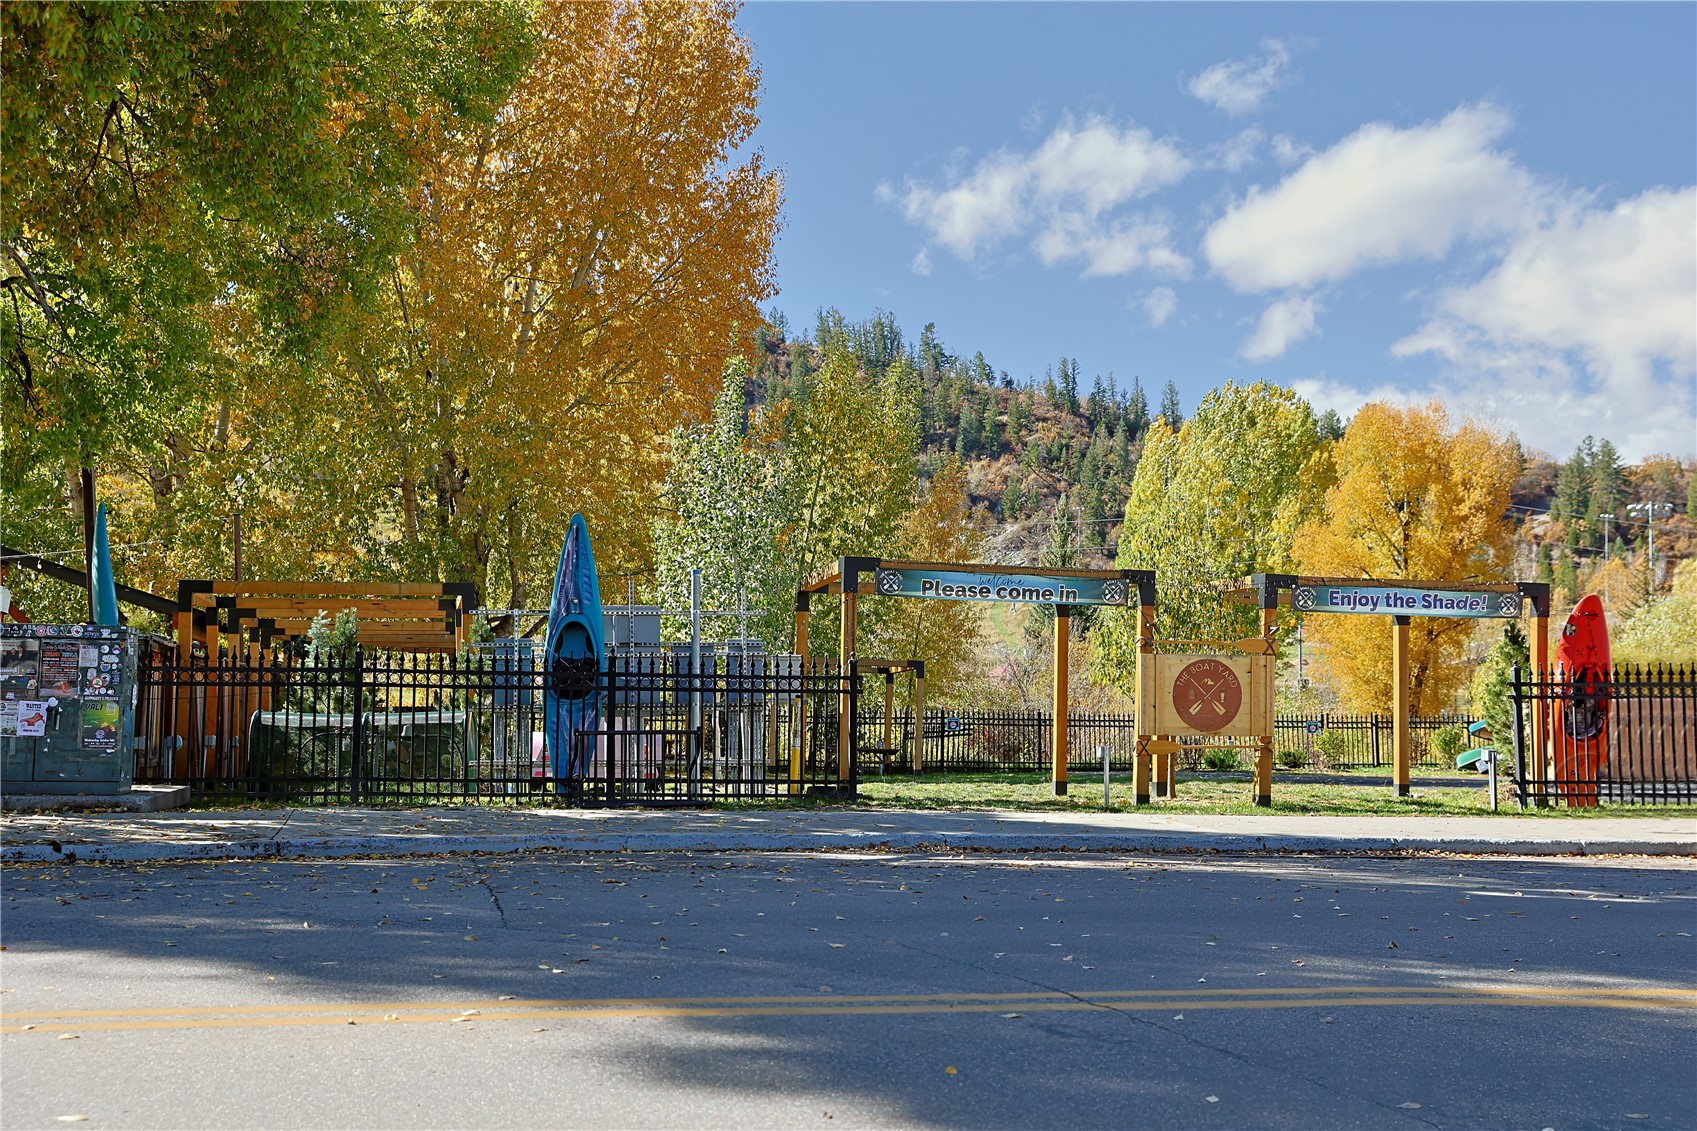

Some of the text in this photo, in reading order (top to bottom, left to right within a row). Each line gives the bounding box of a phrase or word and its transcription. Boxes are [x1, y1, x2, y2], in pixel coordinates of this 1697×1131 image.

[921, 579, 1079, 602] Please come in
[979, 574, 1025, 590] welcome
[1328, 590, 1488, 611] Enjoy the Shade!
[1176, 662, 1238, 688] THE BOAT YARD
